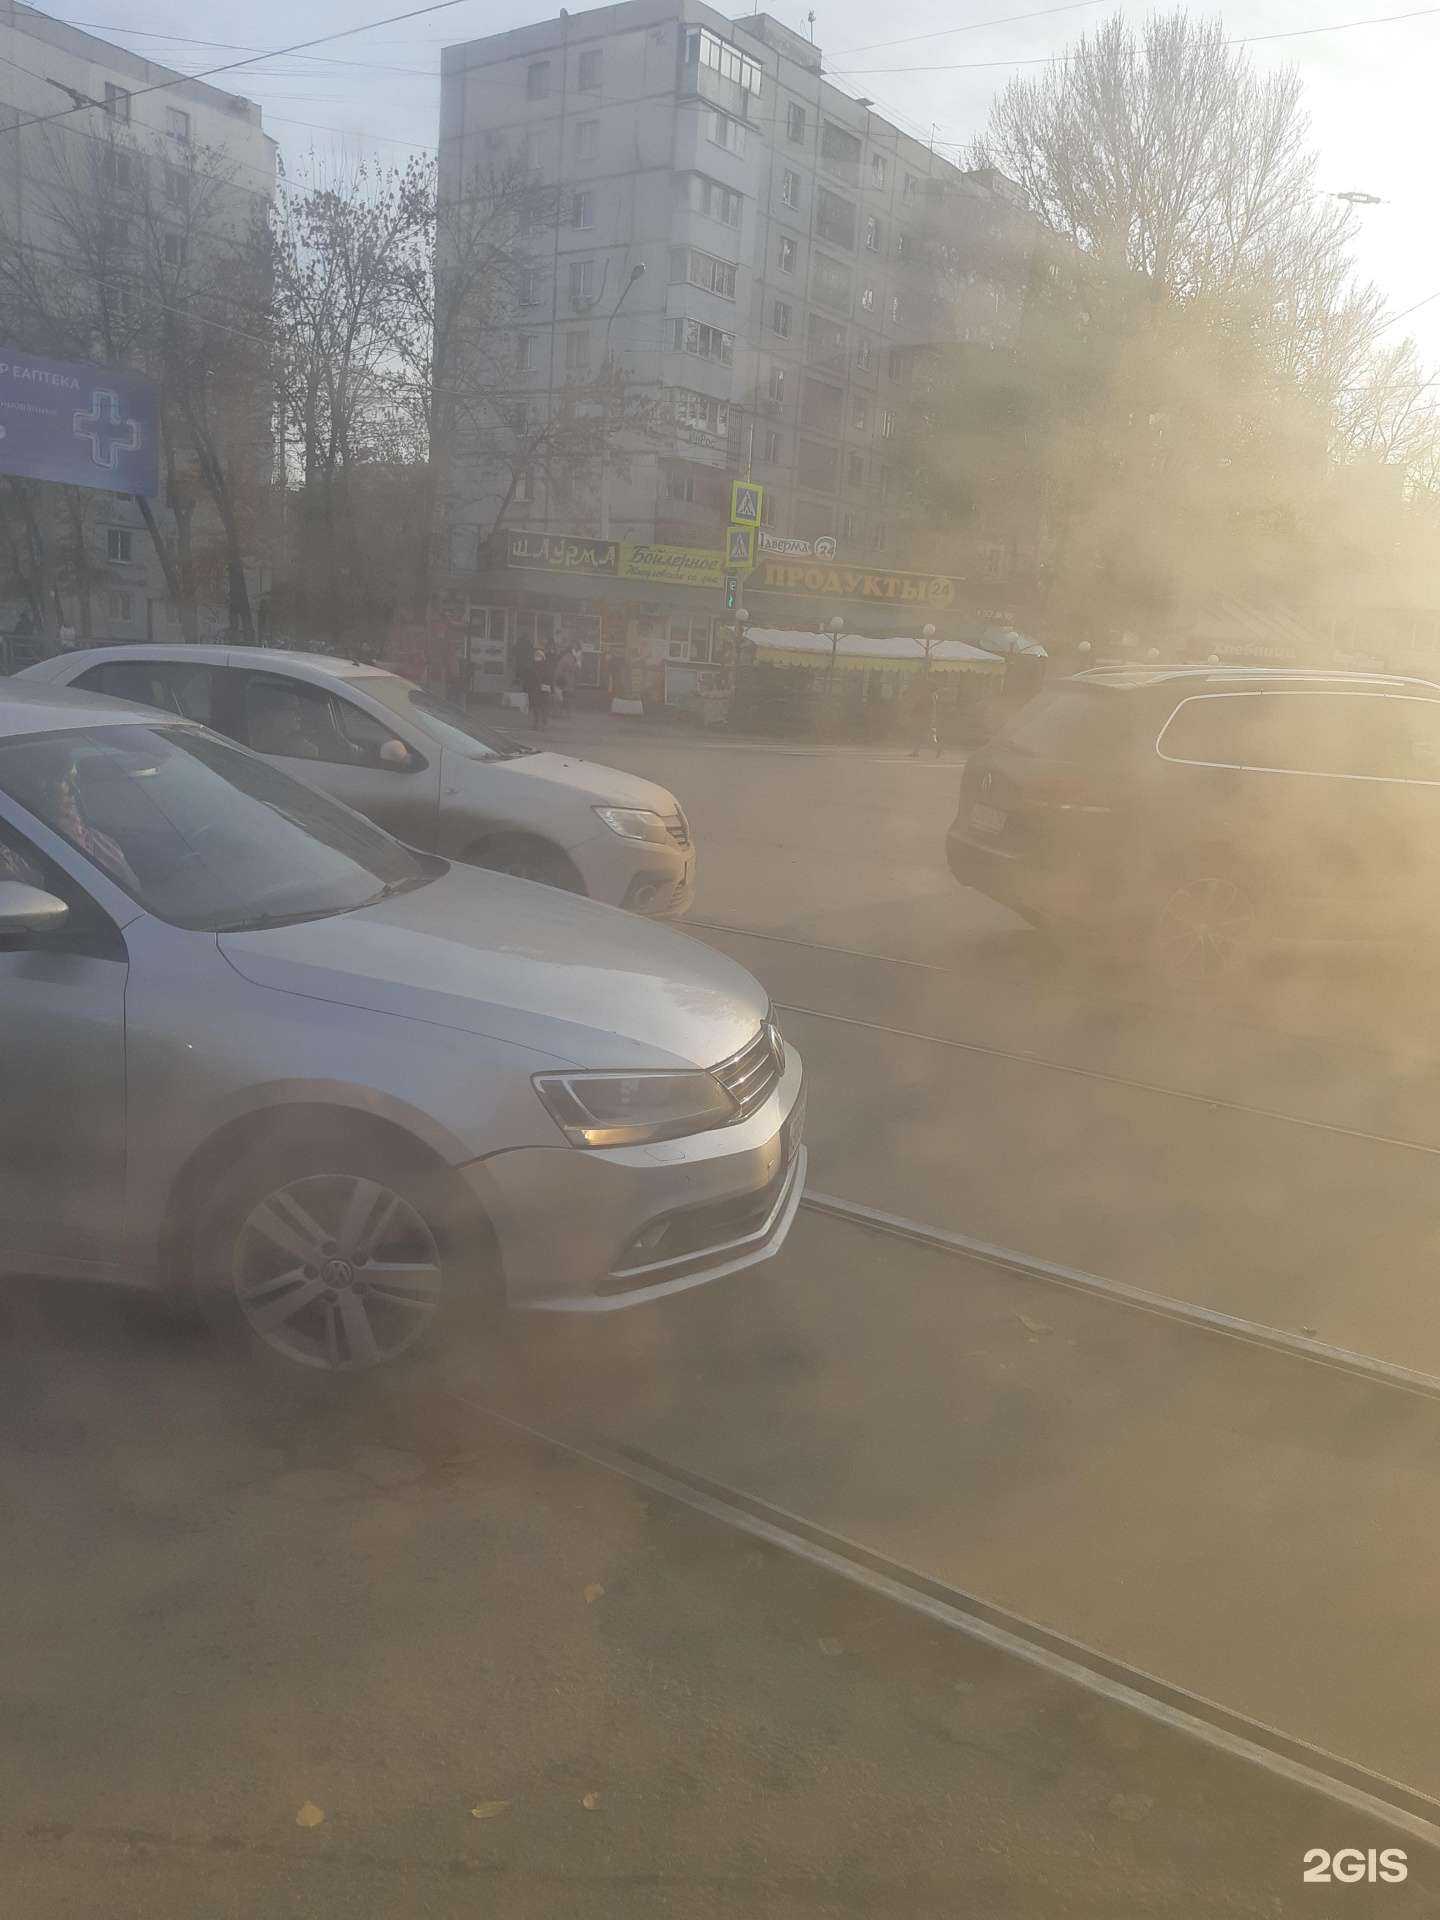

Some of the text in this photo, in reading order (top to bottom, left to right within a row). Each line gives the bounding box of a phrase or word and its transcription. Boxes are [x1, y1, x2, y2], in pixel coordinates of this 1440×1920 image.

[12, 365, 80, 391] ЕАПТЕКА
[512, 538, 617, 569] ШАУРМА
[764, 565, 951, 600] ПРОДУКТЫ 24
